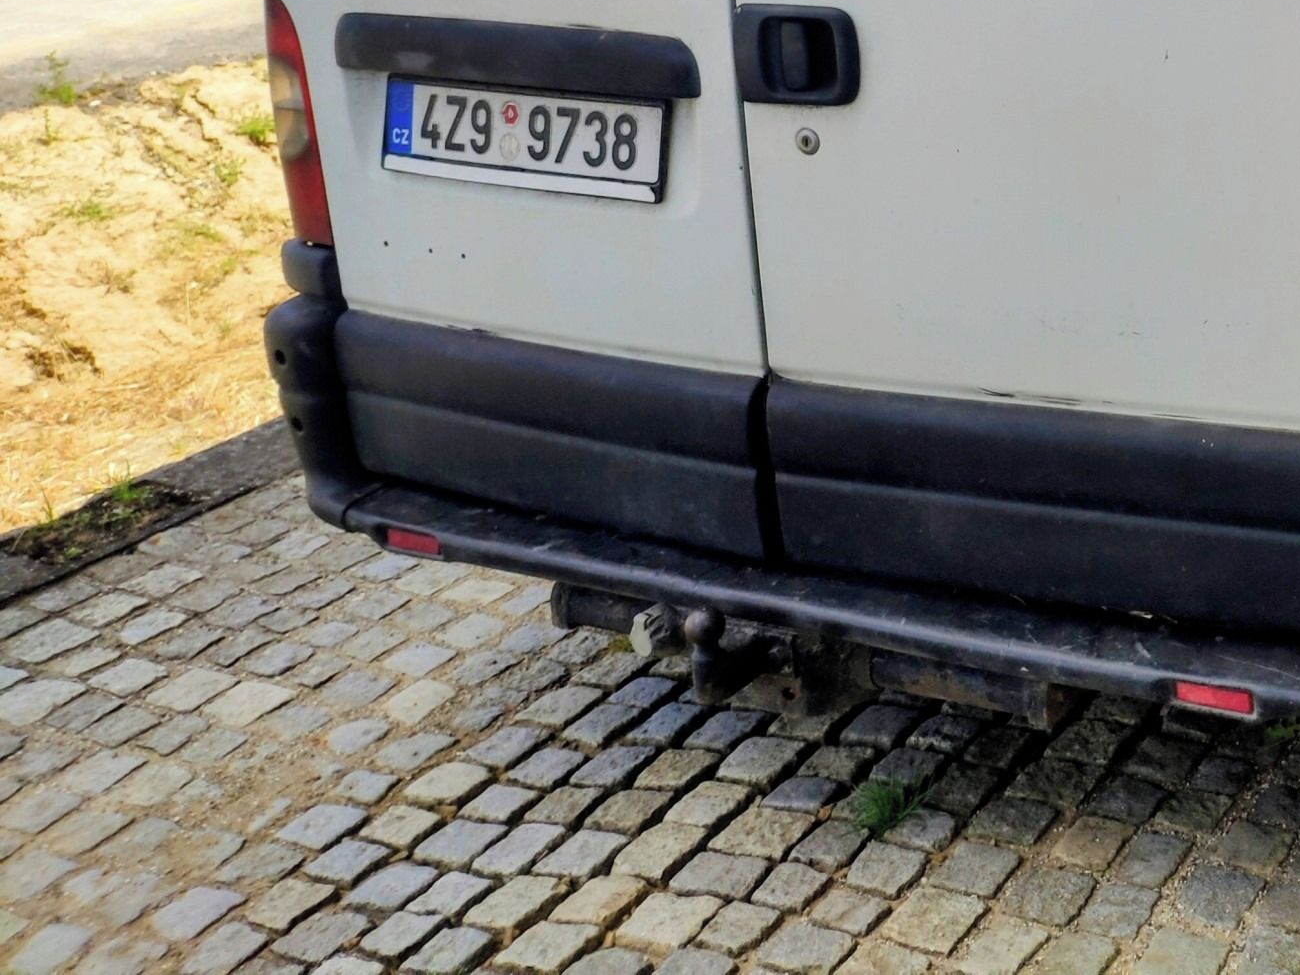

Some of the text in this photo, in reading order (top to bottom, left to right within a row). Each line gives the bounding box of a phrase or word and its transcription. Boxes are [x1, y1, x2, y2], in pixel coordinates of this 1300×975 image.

[392, 127, 410, 145] CZ
[420, 93, 638, 171] 4Z9 9738
